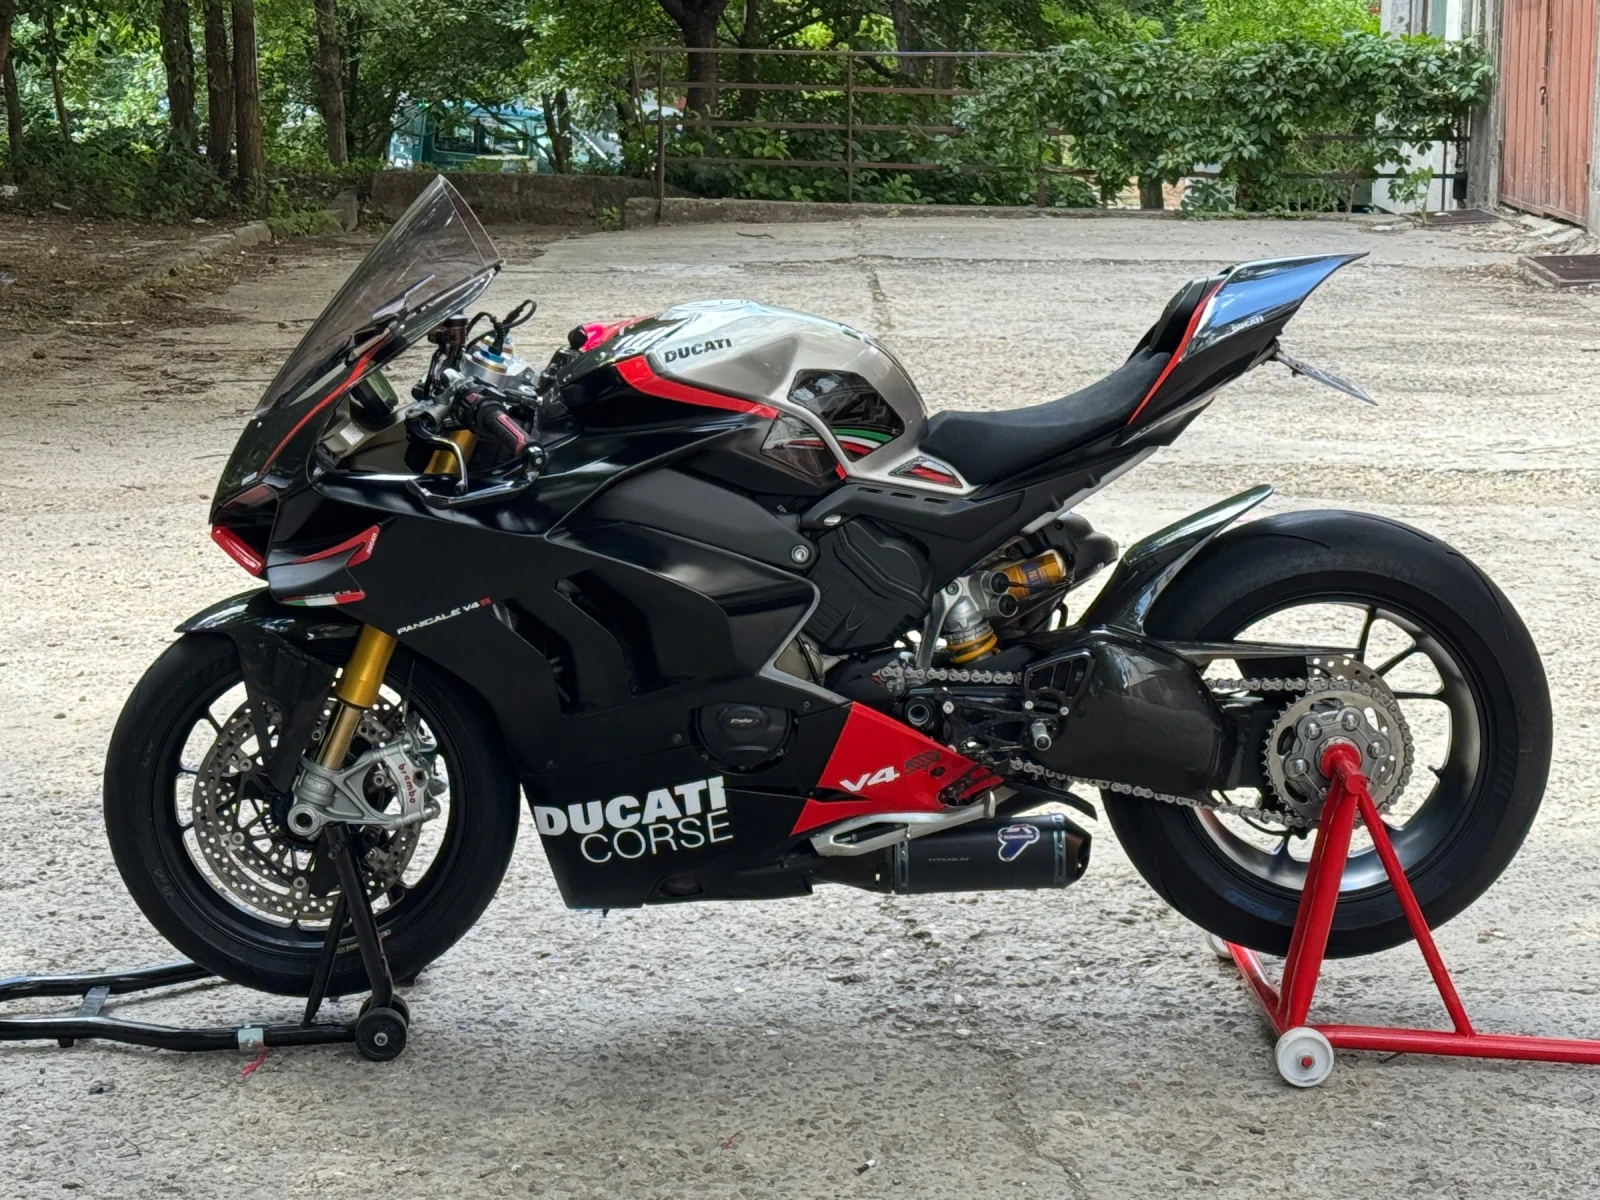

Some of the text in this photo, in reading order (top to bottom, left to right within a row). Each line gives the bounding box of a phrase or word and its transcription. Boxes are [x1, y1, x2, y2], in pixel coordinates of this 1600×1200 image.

[1231, 315, 1264, 333] DUCATI
[663, 338, 732, 364] DUCATI
[398, 763, 417, 804] brembo
[839, 765, 900, 792] V4
[534, 775, 727, 836] DUCATI
[581, 809, 733, 863] CORSE
